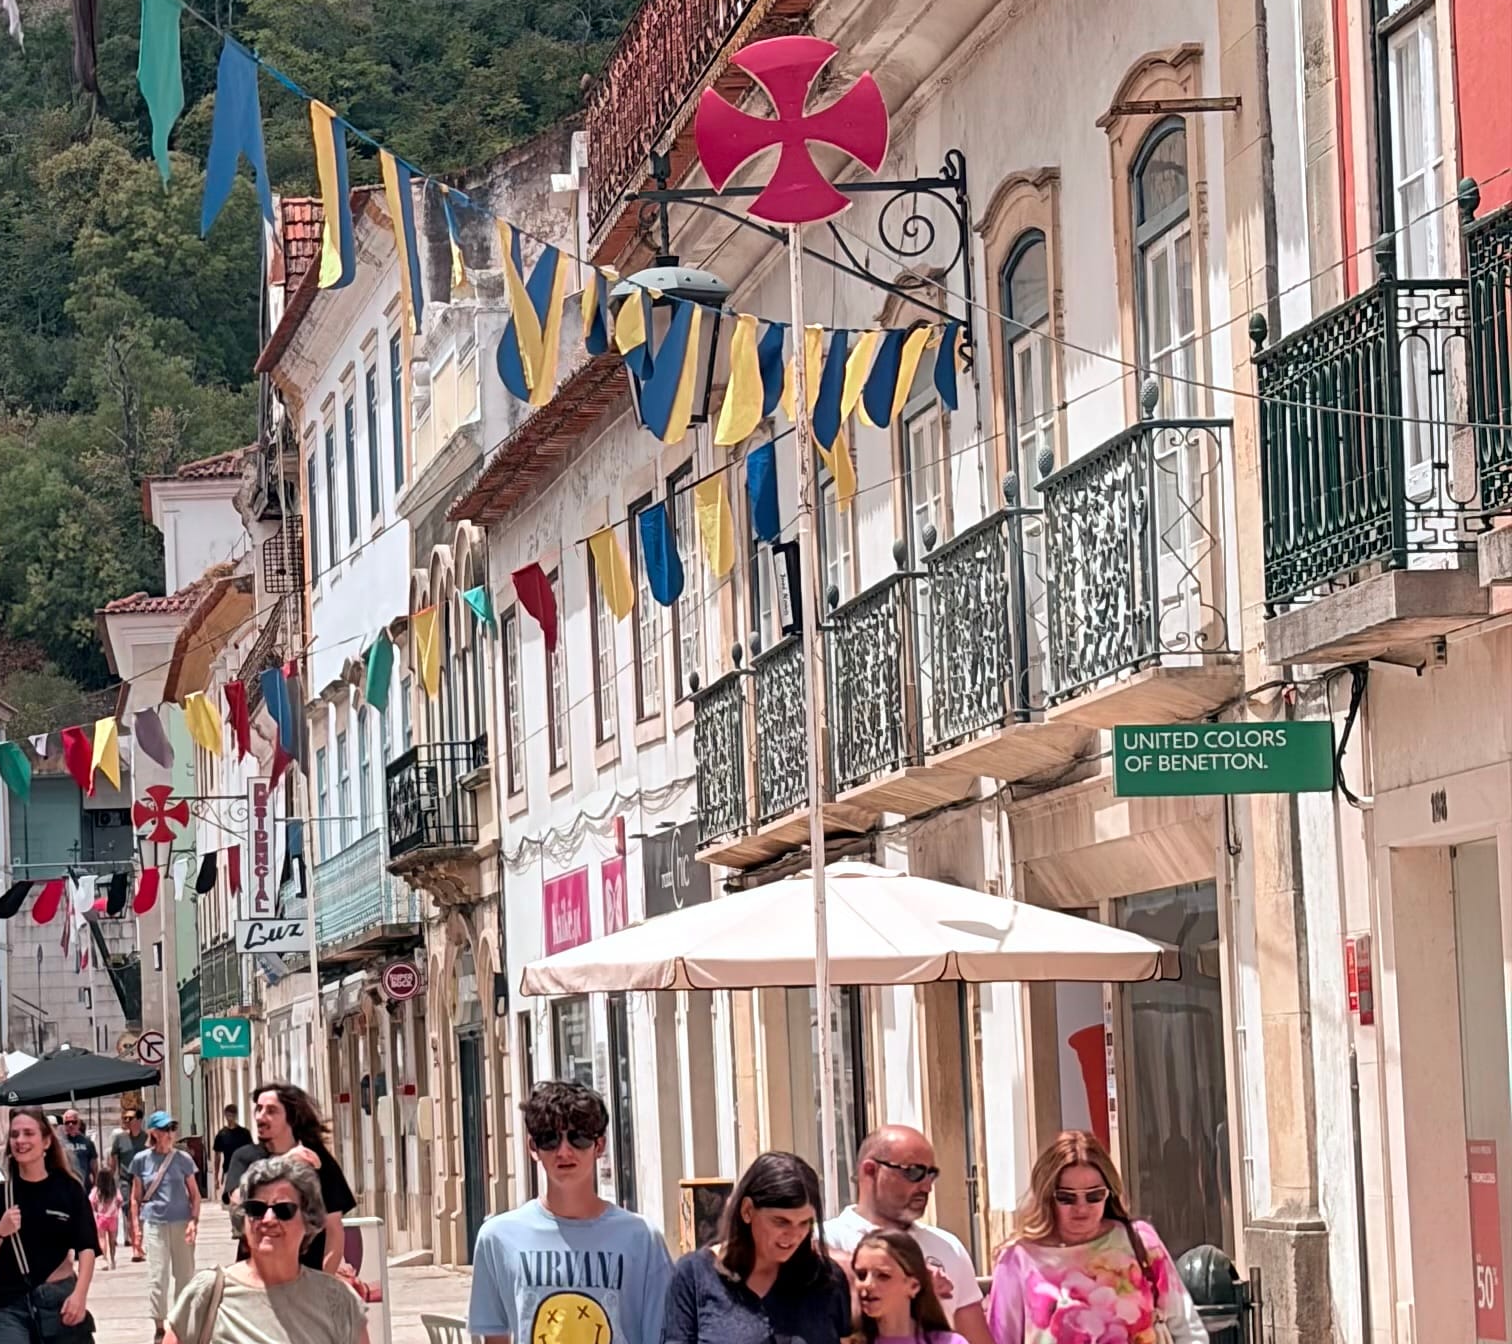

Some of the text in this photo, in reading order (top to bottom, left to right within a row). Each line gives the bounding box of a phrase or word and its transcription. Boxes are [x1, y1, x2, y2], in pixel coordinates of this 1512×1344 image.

[1123, 730, 1287, 750] UNITED COLORS
[1124, 753, 1269, 773] OF BENETTON.
[244, 922, 304, 950] Luz
[520, 1250, 624, 1290] NIRVANA
